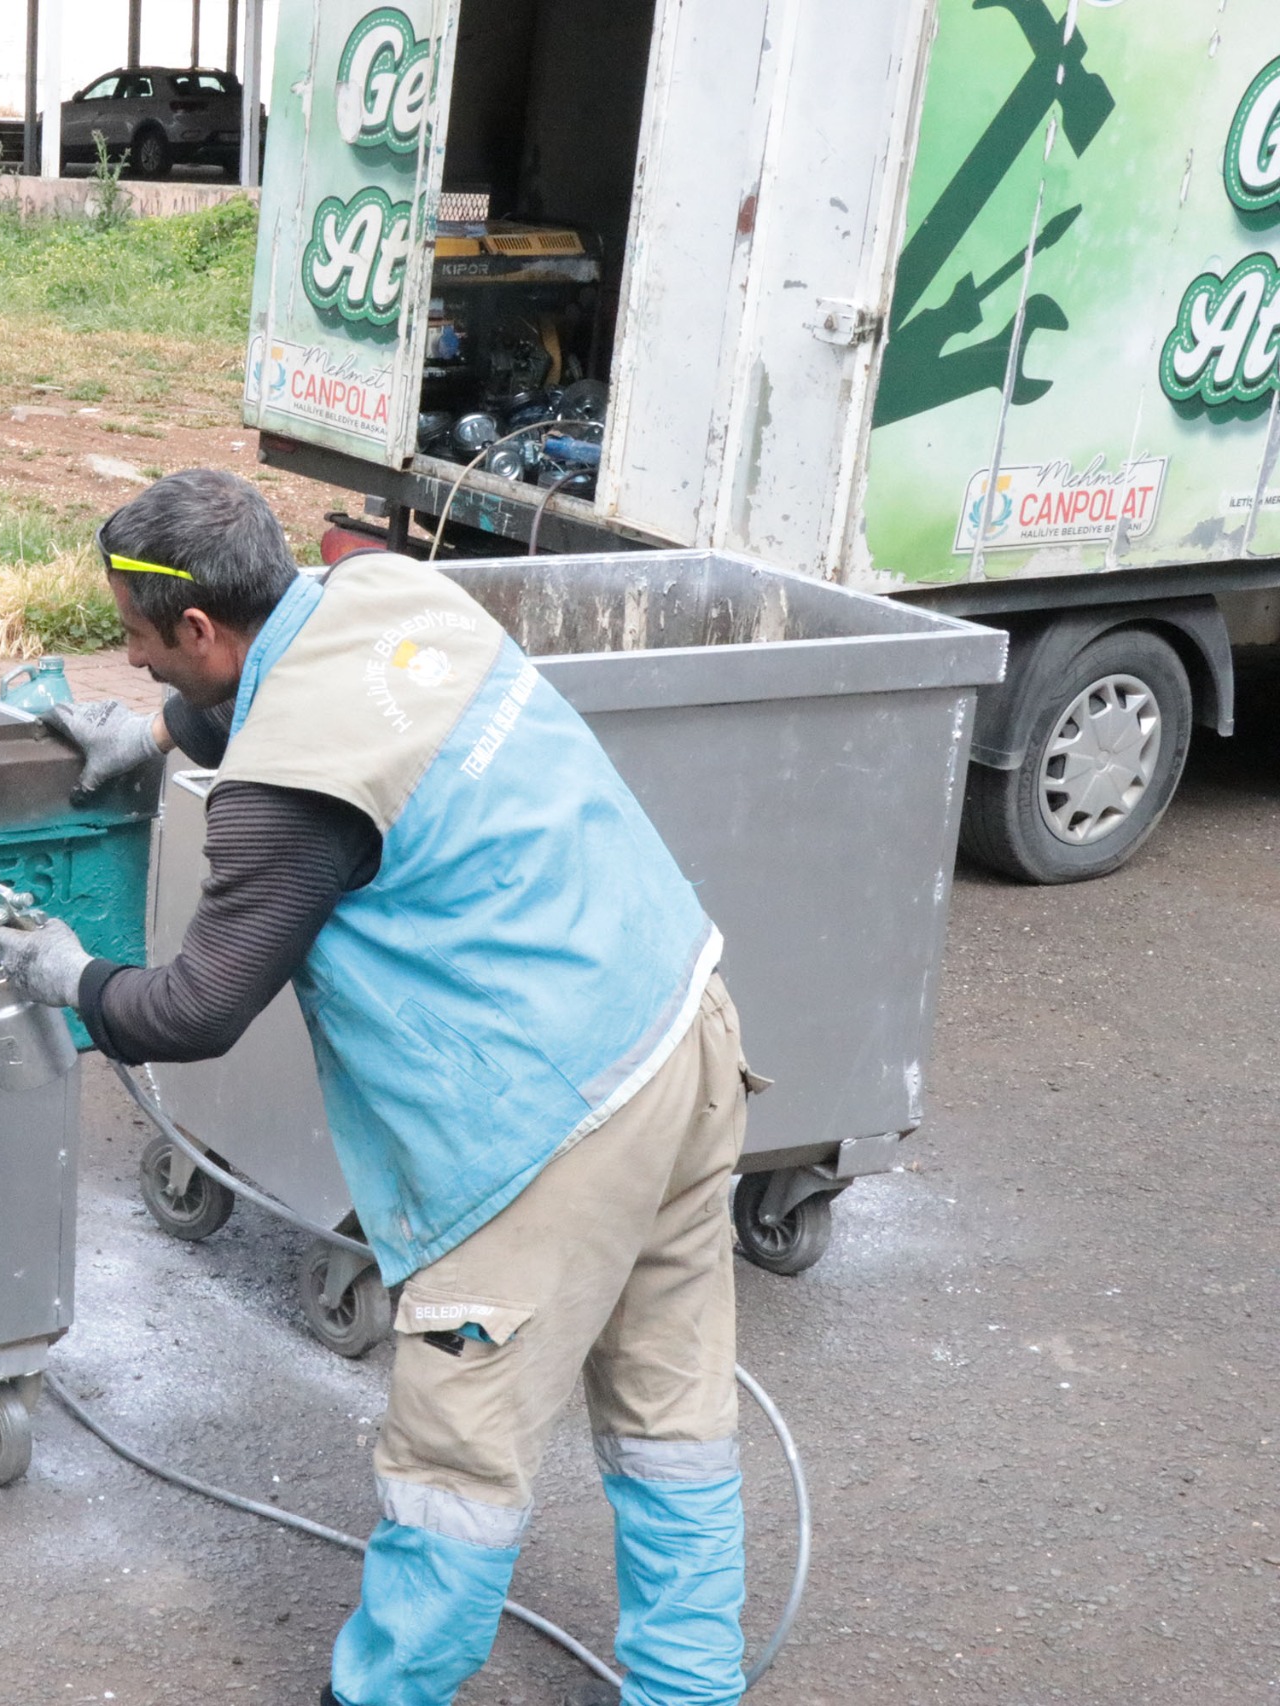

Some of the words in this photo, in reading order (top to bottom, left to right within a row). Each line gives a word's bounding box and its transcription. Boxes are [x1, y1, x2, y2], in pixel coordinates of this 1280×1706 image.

[441, 262, 490, 275] KIPOR
[302, 345, 393, 389] Mehmet
[290, 369, 392, 424] CANPOLA
[293, 402, 325, 418] HALİLİYE
[325, 410, 363, 430] BELEDİYE
[360, 420, 387, 436] BAŞKA
[1037, 450, 1149, 489] Mehmet
[1019, 486, 1153, 527] CANPOLAT
[1021, 527, 1060, 539] HALİLİYE
[1061, 525, 1104, 536] BELEDİYE
[1104, 521, 1142, 534] BAANI
